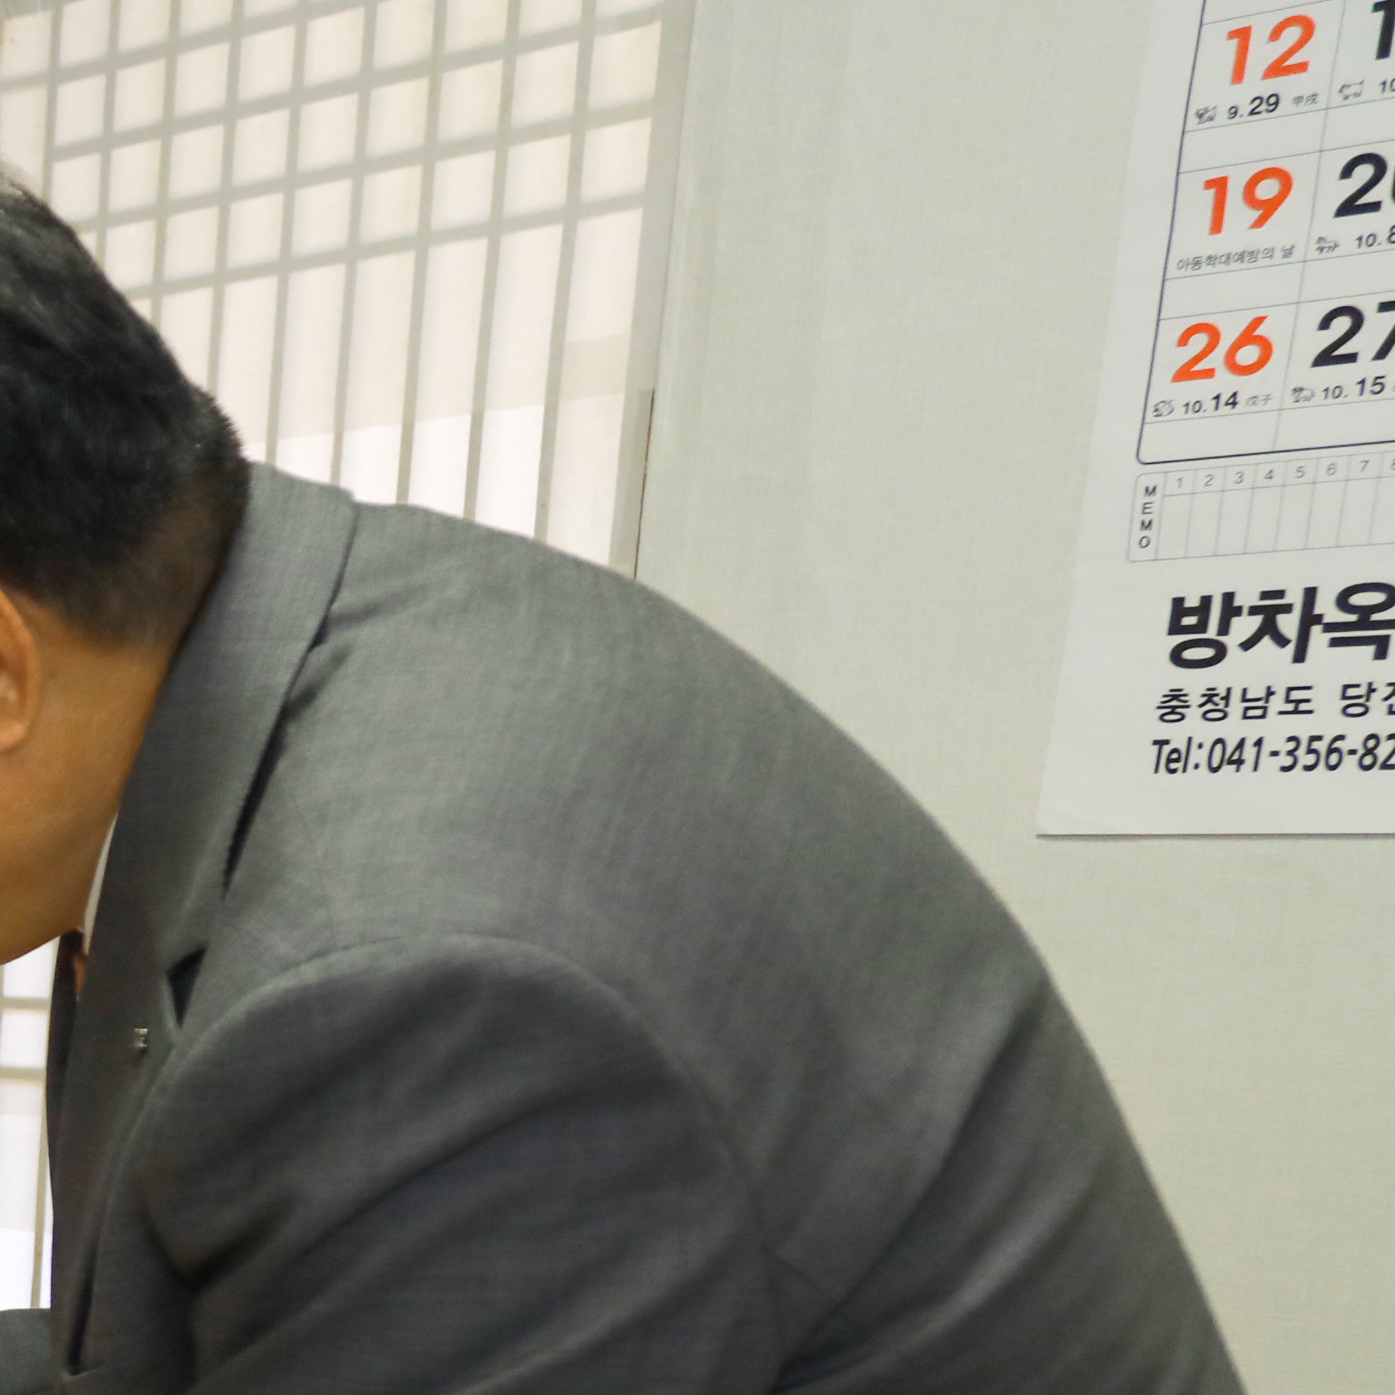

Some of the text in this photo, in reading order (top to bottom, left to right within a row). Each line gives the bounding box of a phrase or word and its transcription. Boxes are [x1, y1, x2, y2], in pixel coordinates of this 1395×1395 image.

[1225, 13, 1316, 86] 12
[1202, 166, 1294, 236] 19
[1280, 243, 1296, 259] 날
[1170, 315, 1274, 384] 26
[1203, 474, 1215, 487] 2
[1233, 472, 1245, 485] 3
[1263, 469, 1275, 482] 4
[1294, 466, 1306, 479] 5
[1326, 462, 1338, 476] 6
[1359, 460, 1370, 473] 7
[1137, 484, 1157, 549] MEMO
[1166, 582, 1395, 669] 방차옥
[1155, 685, 1315, 724] 충청남도
